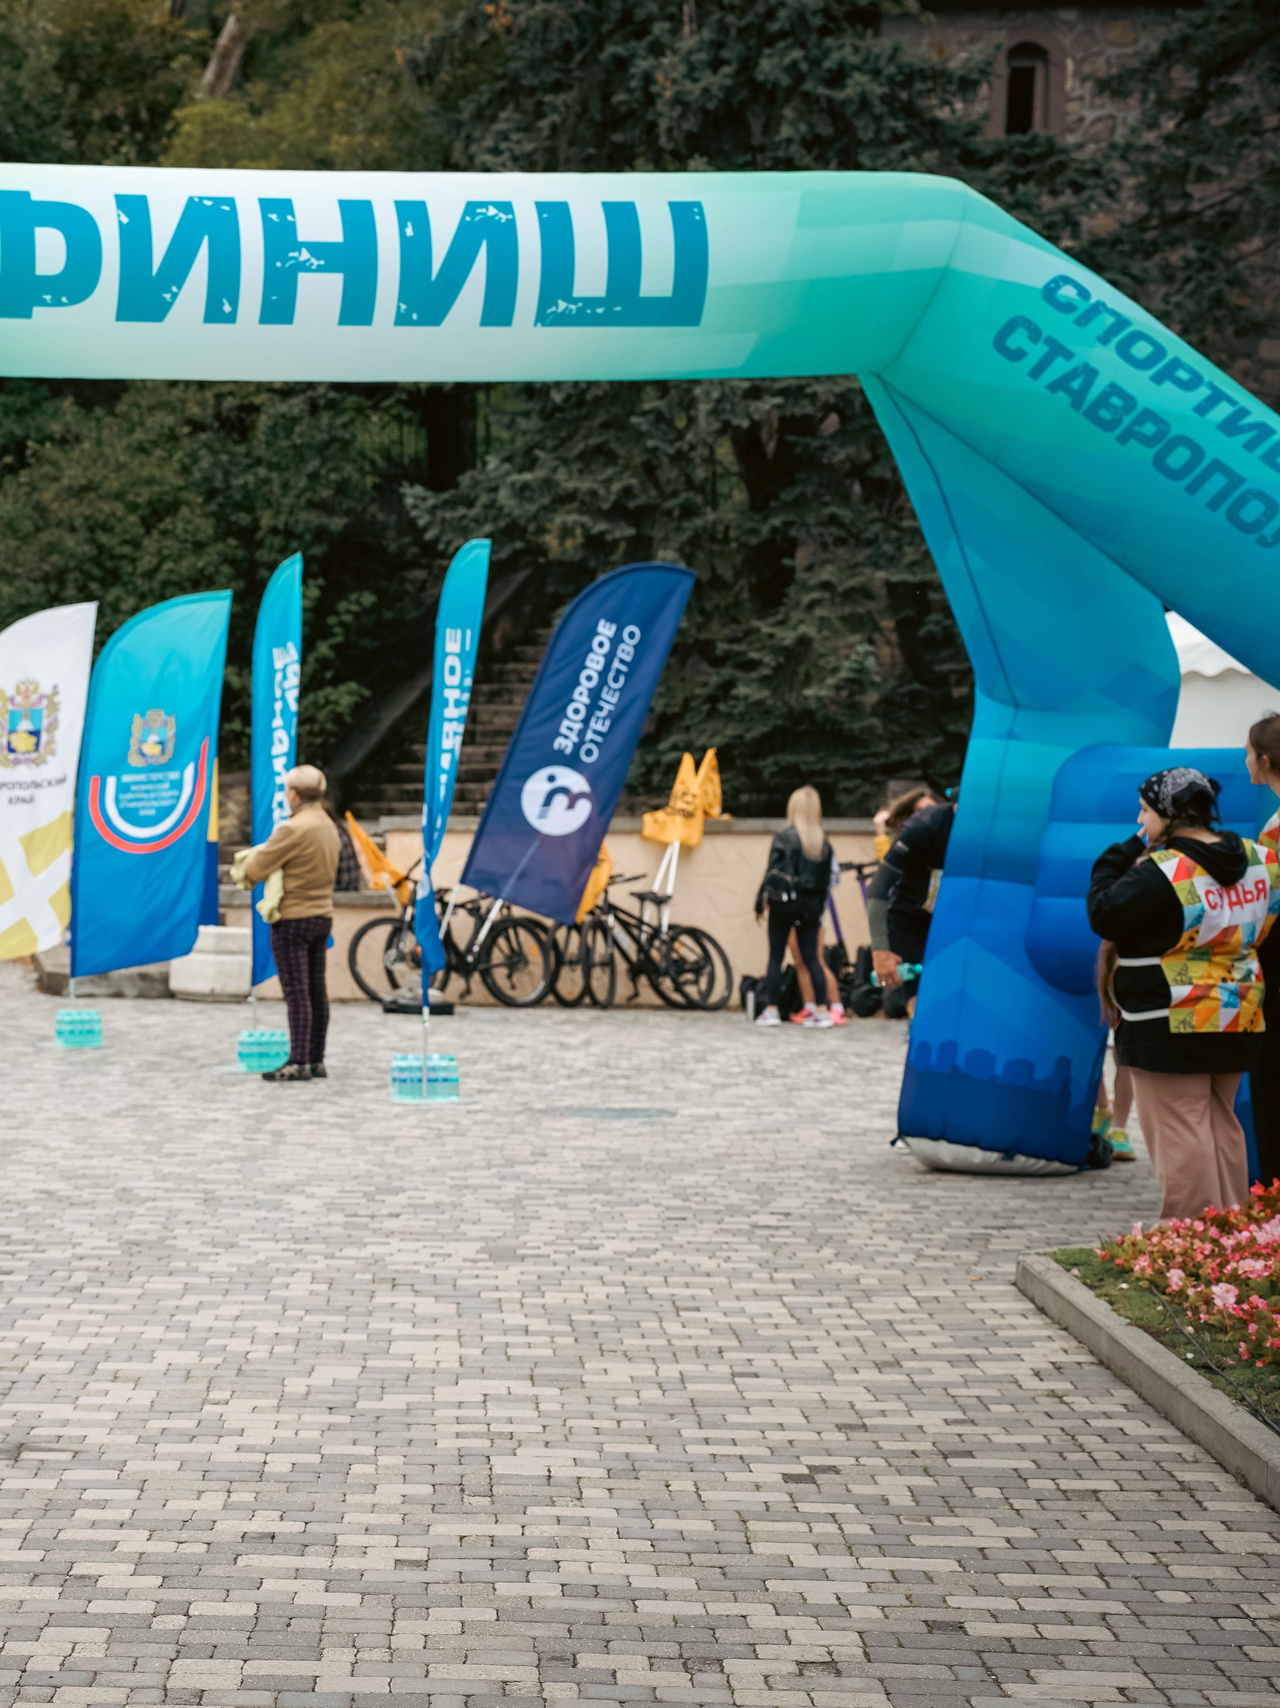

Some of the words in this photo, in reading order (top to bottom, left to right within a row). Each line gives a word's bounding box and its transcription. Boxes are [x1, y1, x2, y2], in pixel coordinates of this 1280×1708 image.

[552, 618, 618, 756] ЗДОРОВОЕ
[579, 624, 642, 764] ОТЕЧЕСТВО
[1204, 878, 1267, 912] СУДЬЯ
